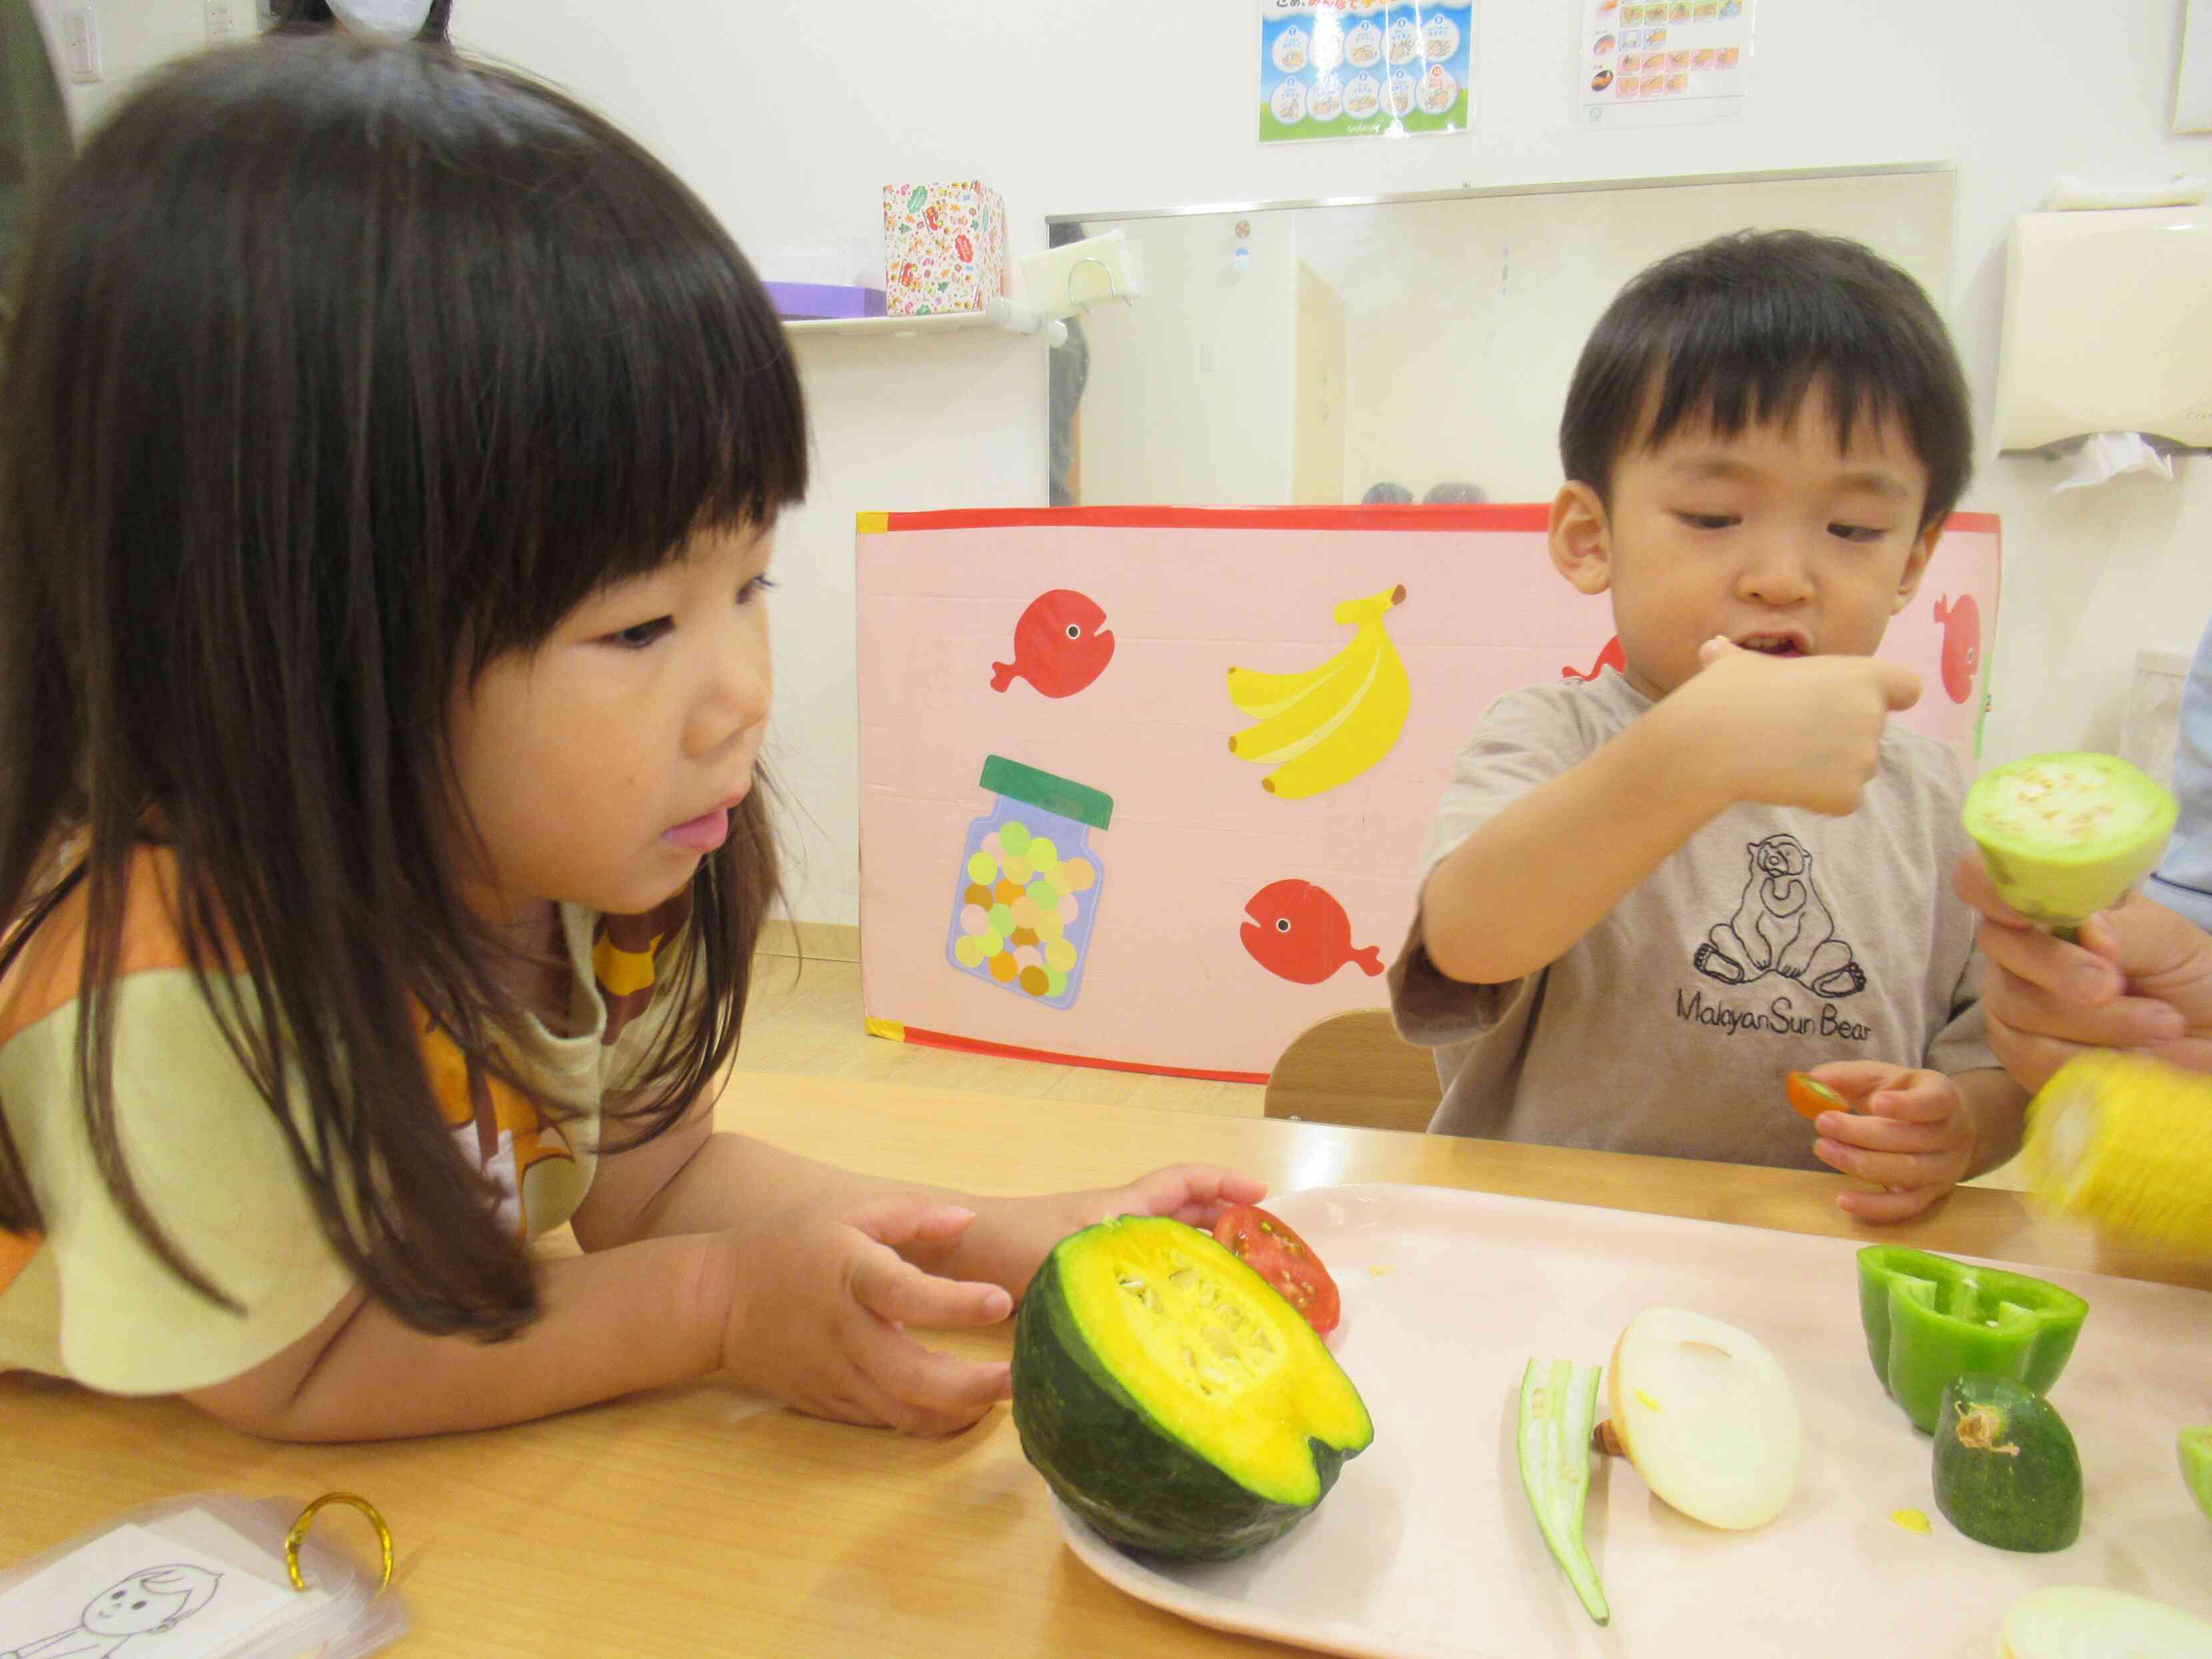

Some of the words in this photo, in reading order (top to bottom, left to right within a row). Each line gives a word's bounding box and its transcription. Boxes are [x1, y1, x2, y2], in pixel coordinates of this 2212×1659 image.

[1677, 988, 1769, 1035] Malayan
[1770, 996, 1815, 1034] Sun
[1820, 1002, 1871, 1040] Bear
